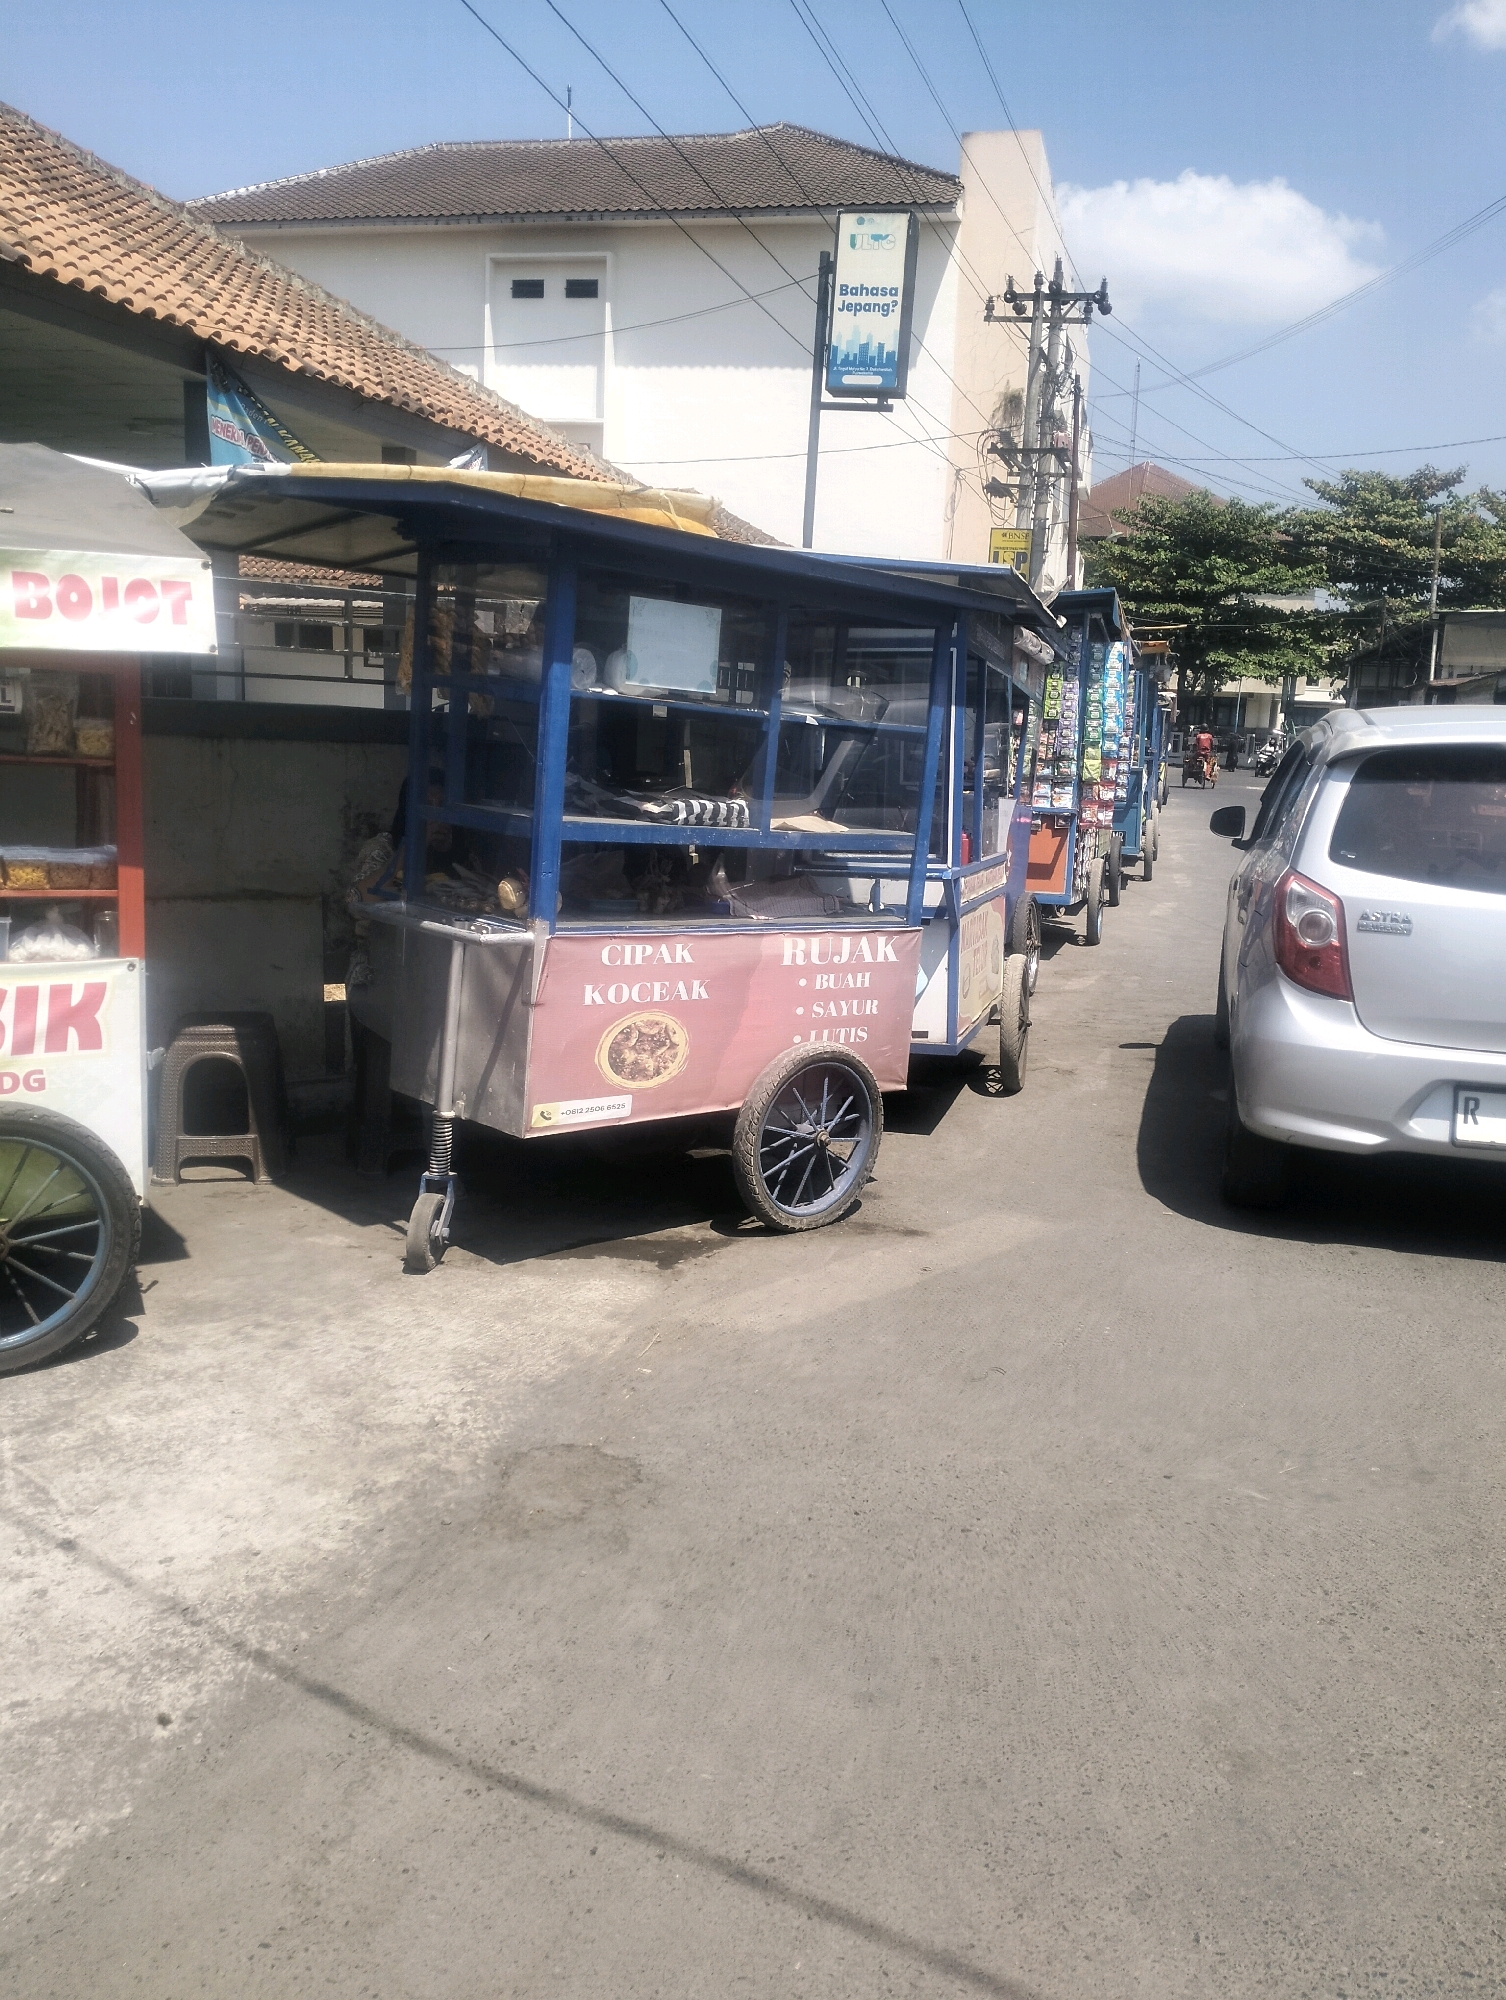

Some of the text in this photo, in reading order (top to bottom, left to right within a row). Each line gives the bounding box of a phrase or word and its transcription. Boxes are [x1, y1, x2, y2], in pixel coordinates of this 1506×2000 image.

[839, 283, 899, 297] Bahasa
[837, 299, 899, 317] Jepang?
[601, 943, 695, 966] CIPAK
[781, 936, 899, 966] RUJAK
[815, 972, 871, 990] BUAH
[583, 979, 710, 1006] KOCEAK
[811, 999, 879, 1018] SAYUR
[1463, 1096, 1480, 1125] R
